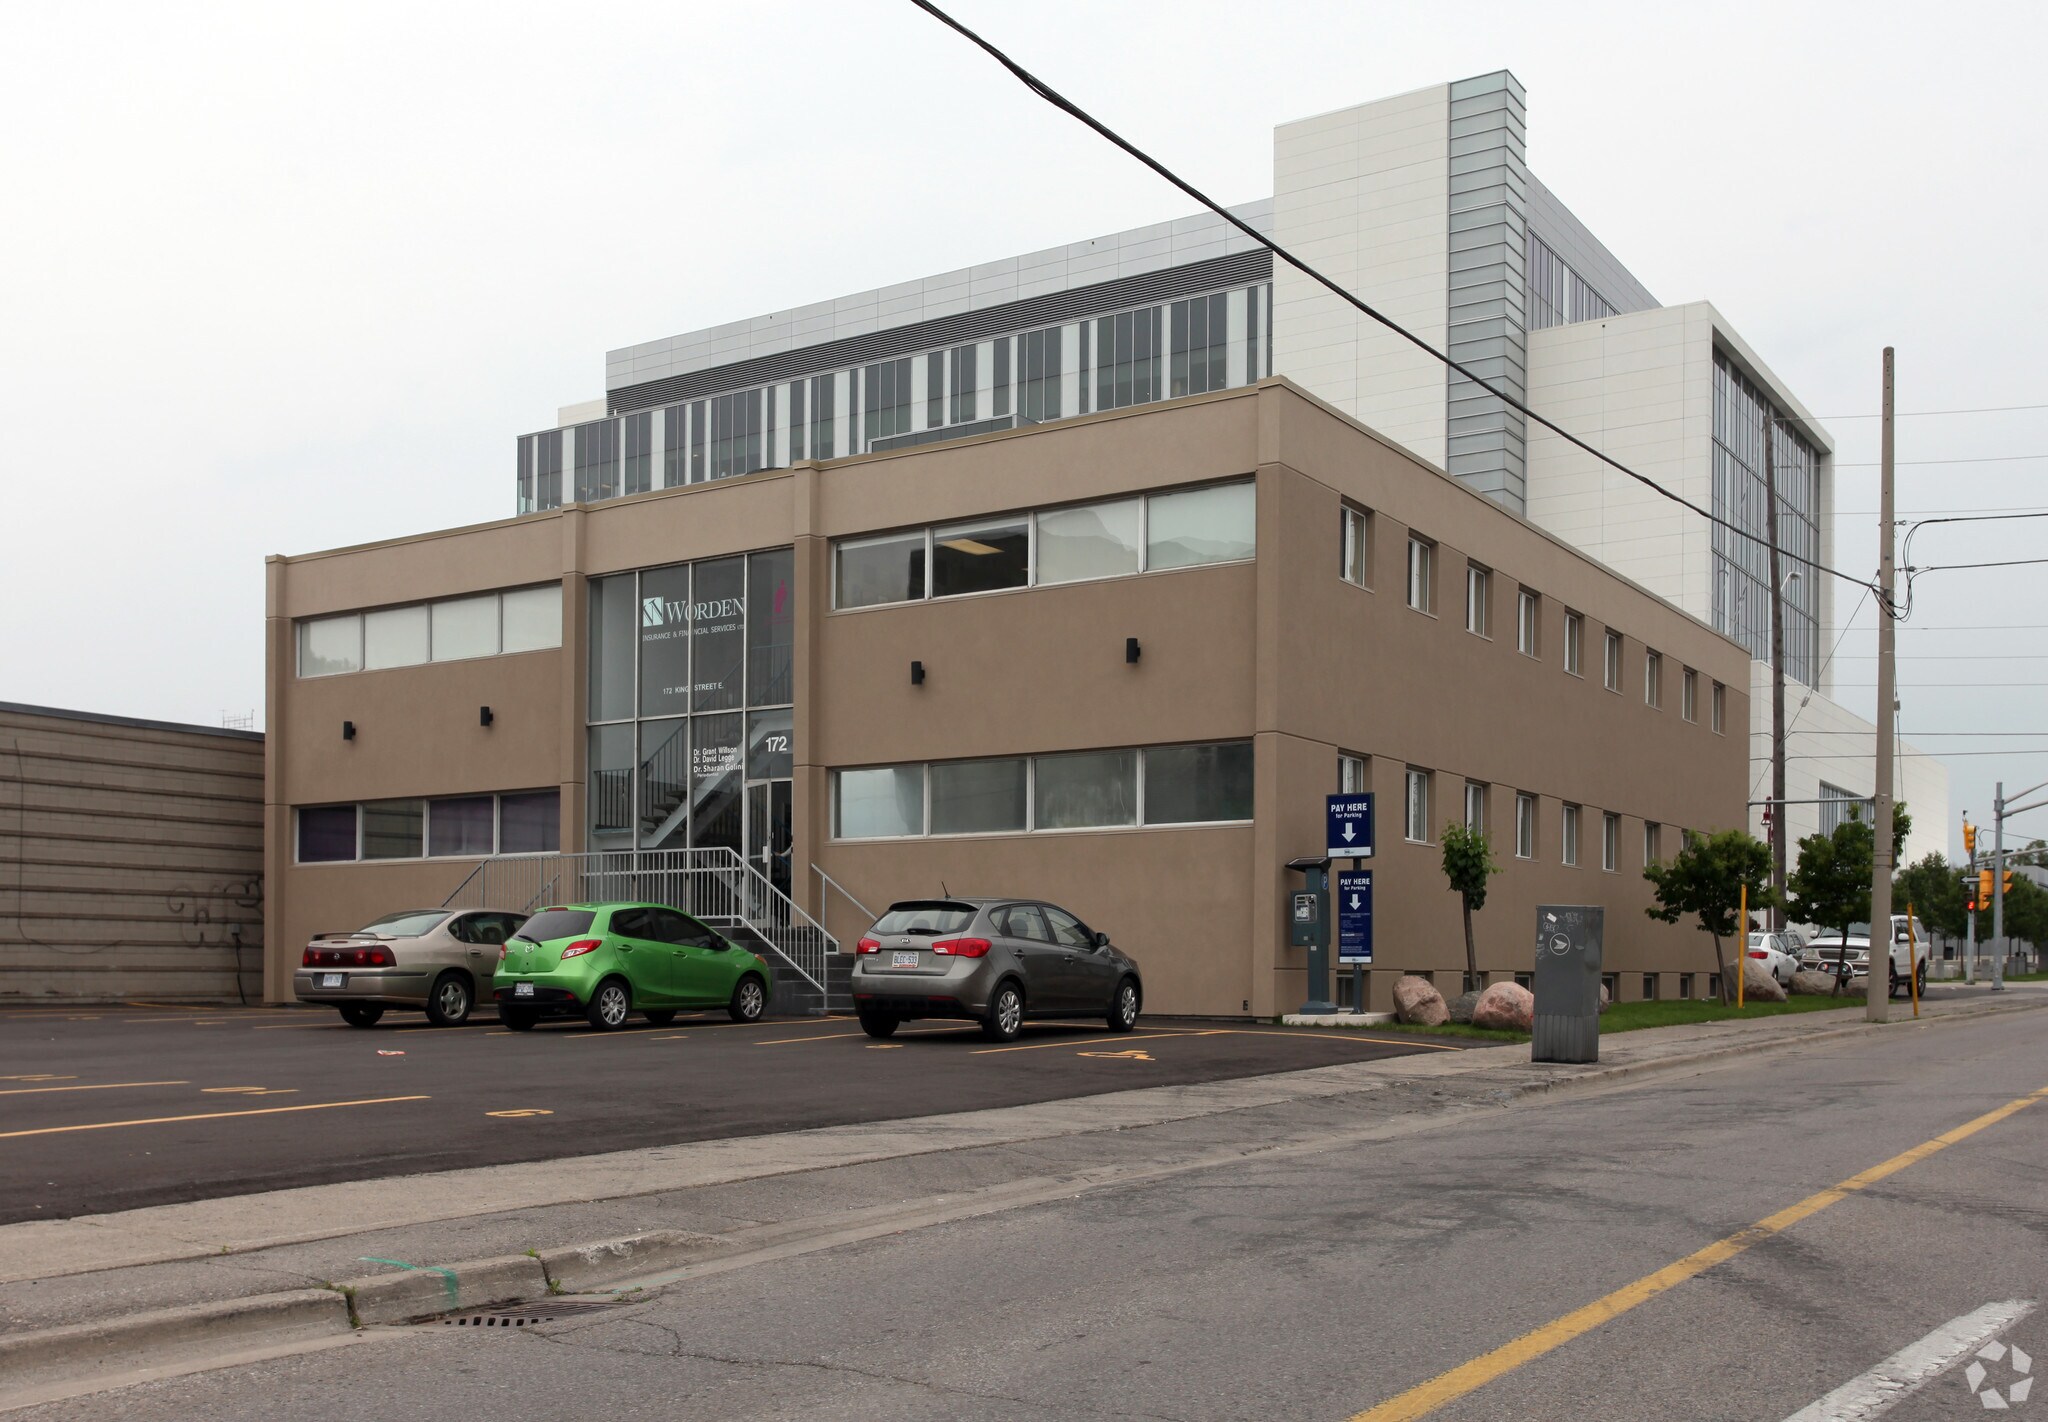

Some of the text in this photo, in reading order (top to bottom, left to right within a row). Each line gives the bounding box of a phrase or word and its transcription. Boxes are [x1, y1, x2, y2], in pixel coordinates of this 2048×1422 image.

[665, 597, 745, 623] WORDEN
[642, 631, 671, 642] INSURANCE
[673, 630, 678, 638] &
[679, 625, 708, 636] FINNCIAL
[711, 623, 736, 633] SERVICES
[663, 687, 672, 695] 172
[694, 682, 718, 691] STREET
[766, 736, 787, 752] 172
[702, 747, 717, 755] Grant
[702, 754, 717, 763] David
[1331, 803, 1367, 812] PAY HERE
[1340, 877, 1371, 886] PAY HERE
